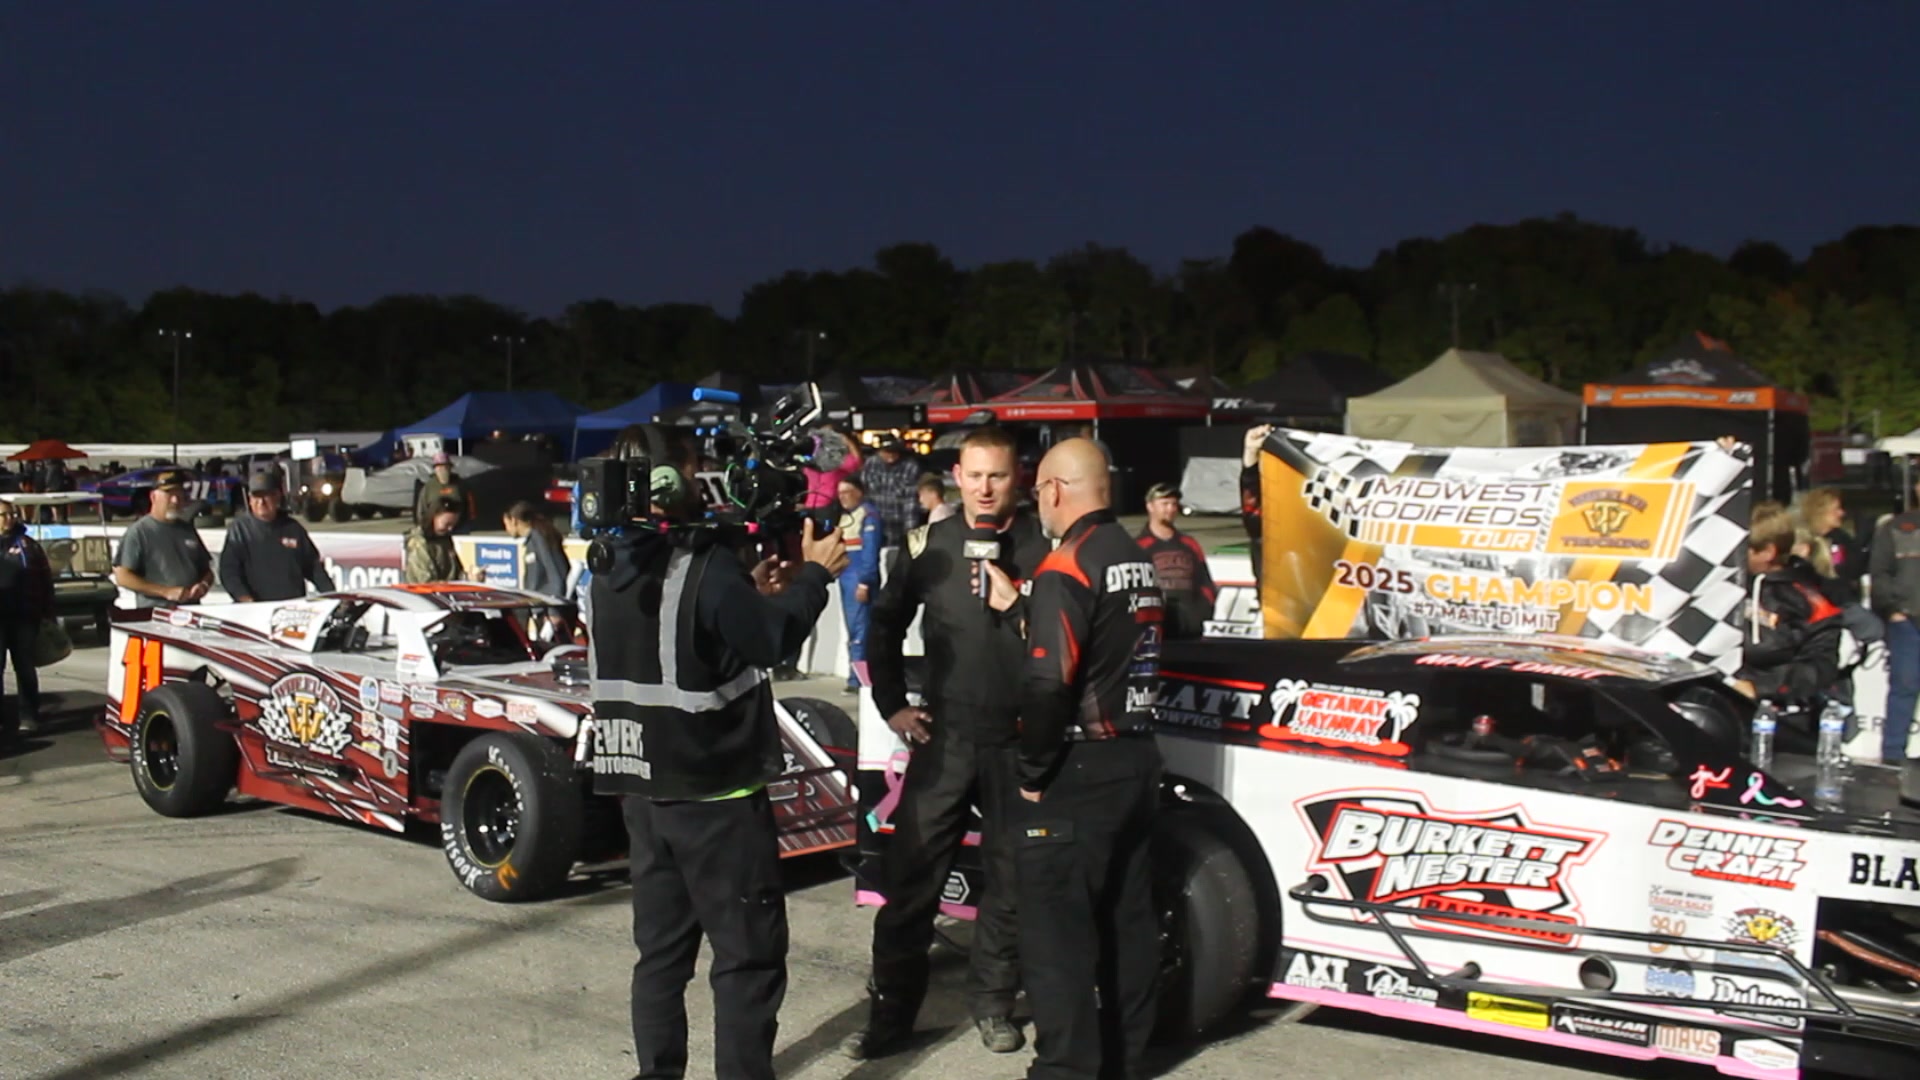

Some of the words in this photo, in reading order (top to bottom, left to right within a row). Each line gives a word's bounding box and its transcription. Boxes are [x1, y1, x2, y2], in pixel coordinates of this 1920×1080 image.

[1374, 478, 1551, 503] MIDWEST
[1343, 500, 1543, 527] MODIFIEDS
[1459, 529, 1532, 549] TOUR
[1336, 562, 1414, 594] 2025
[1426, 573, 1653, 612] CHAMPION
[1440, 605, 1493, 624] MATT
[1499, 611, 1561, 630] DIMIT
[1414, 653, 1500, 669] MATT
[119, 636, 163, 725] 11
[1302, 691, 1390, 717] GETAWAY
[1322, 808, 1588, 863] BURKETT
[1649, 820, 1805, 861] DENNIS
[1374, 854, 1560, 898] NESTER
[1667, 847, 1806, 883] CRAFT
[1850, 852, 1920, 891] BLA
[1285, 953, 1349, 986] AXT
[1656, 1024, 1720, 1056] MAYS
